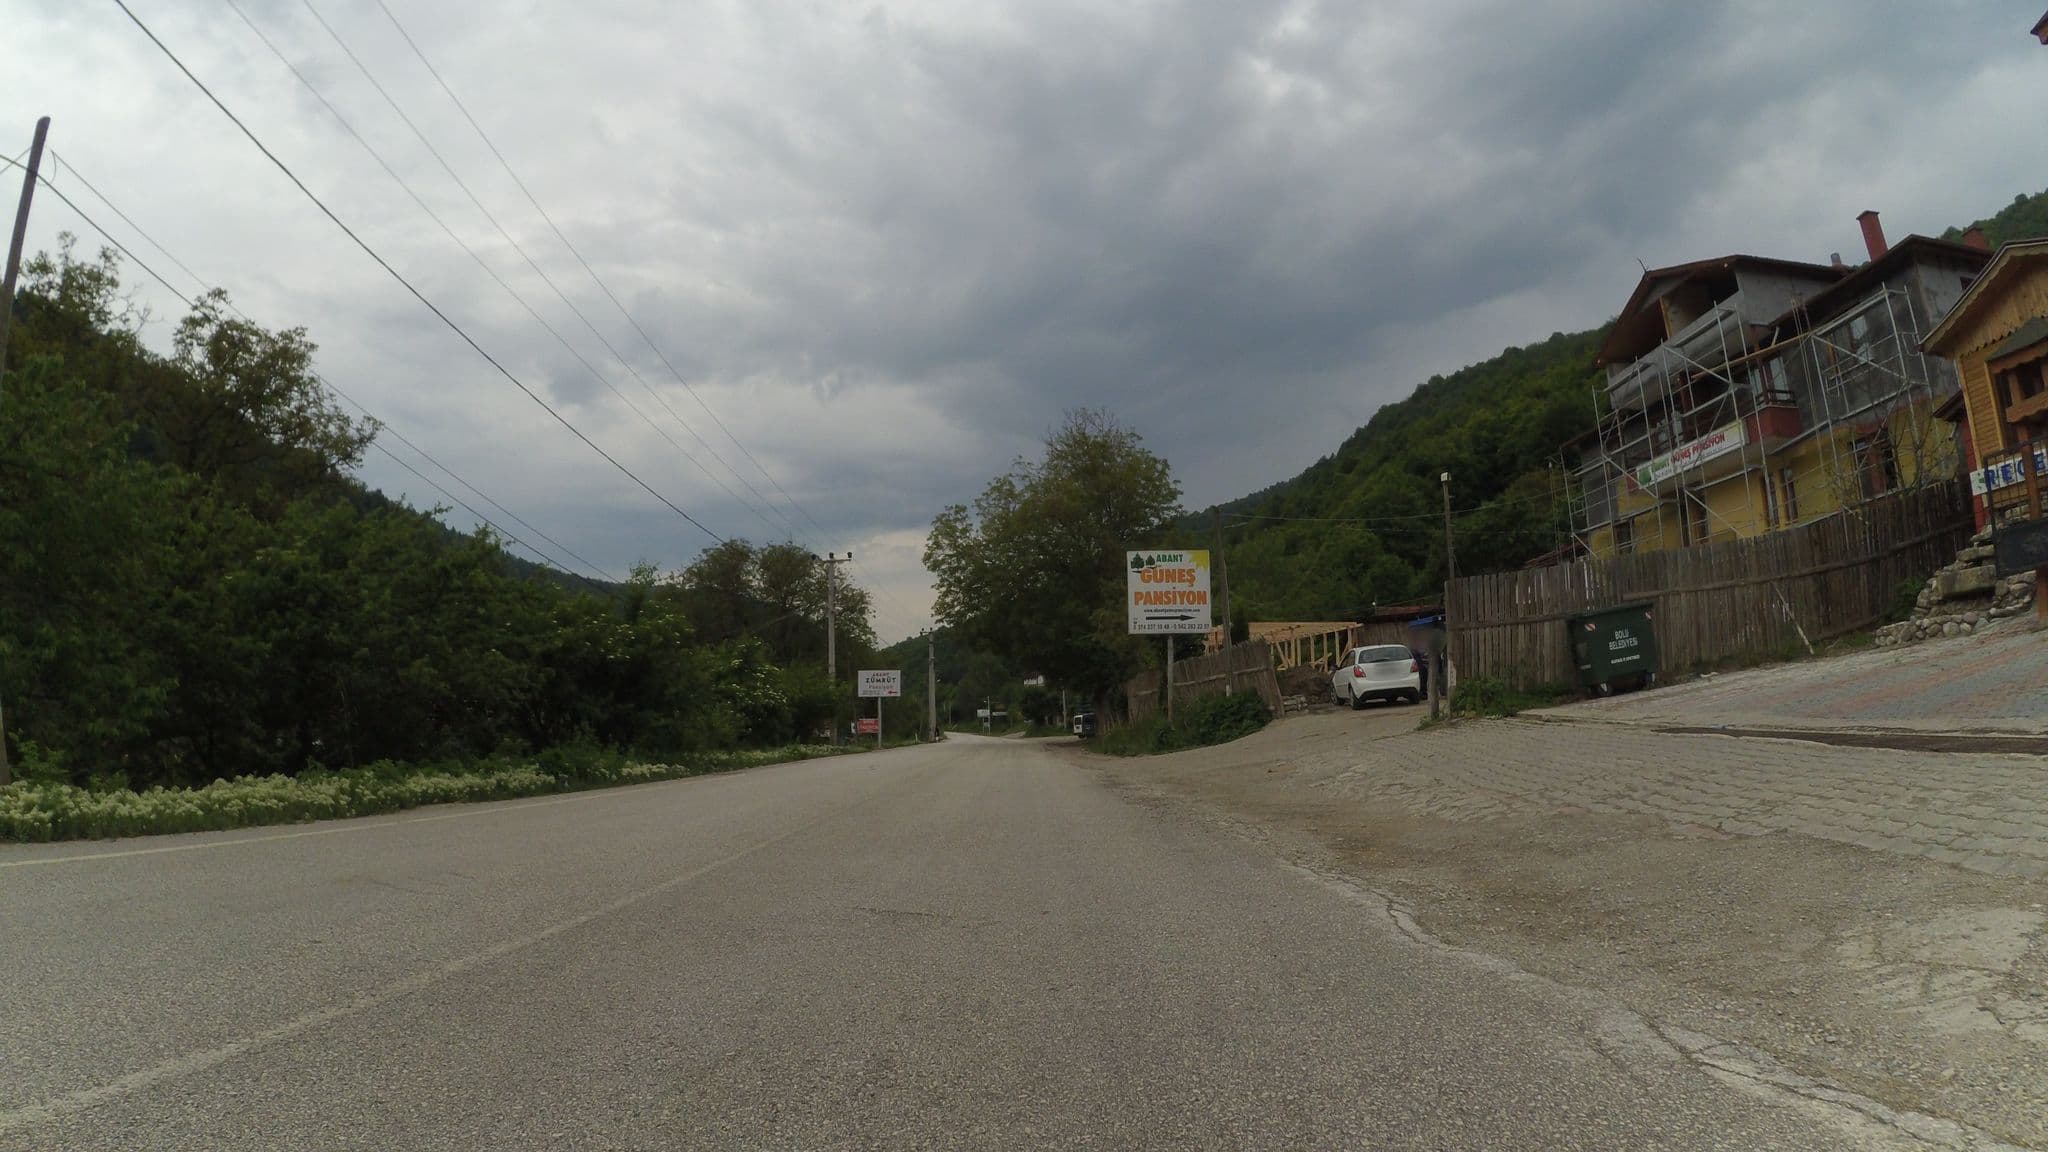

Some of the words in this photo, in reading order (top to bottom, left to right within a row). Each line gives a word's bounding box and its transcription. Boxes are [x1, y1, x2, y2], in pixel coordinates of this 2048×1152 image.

[1156, 554, 1184, 563] ABANT
[1133, 589, 1207, 606] PANSİYON
[1615, 628, 1630, 640] BOLU
